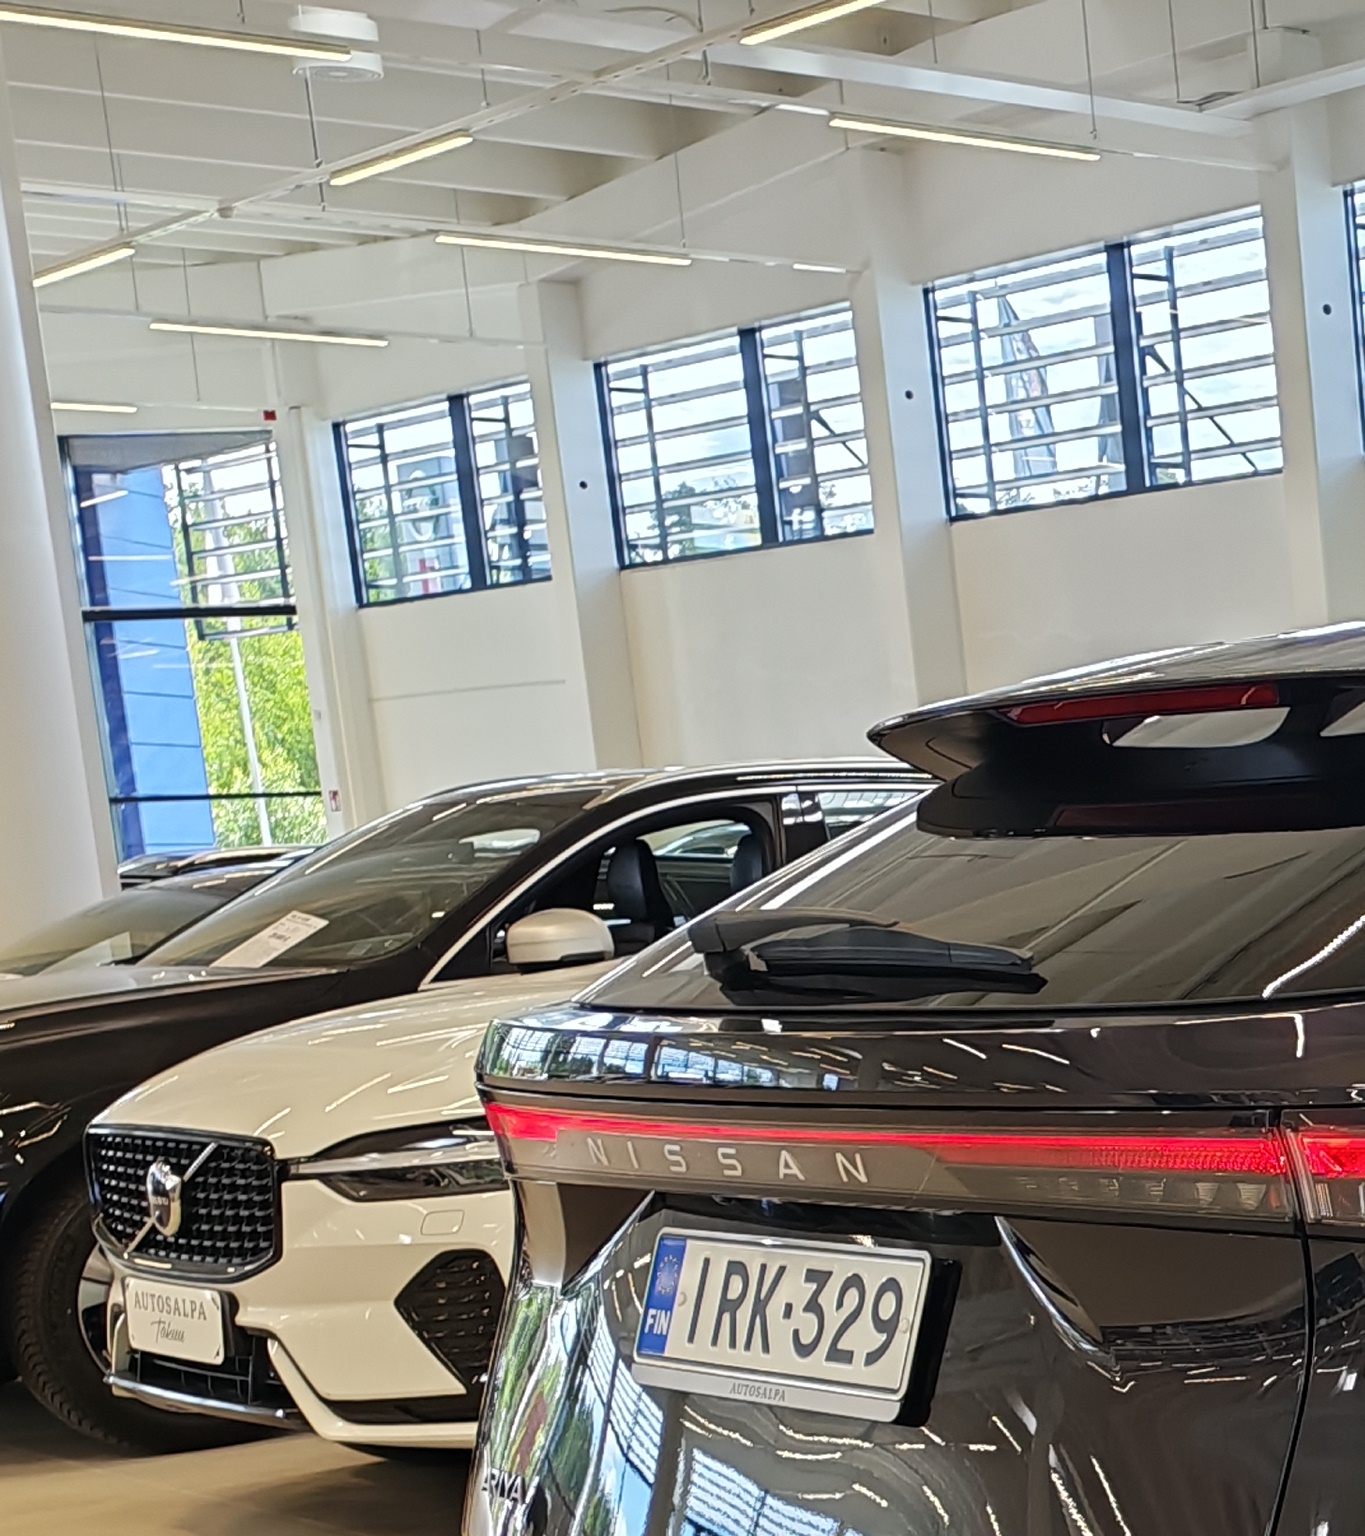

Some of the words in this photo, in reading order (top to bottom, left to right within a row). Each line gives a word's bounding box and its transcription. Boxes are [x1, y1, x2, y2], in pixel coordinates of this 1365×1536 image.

[586, 1136, 869, 1183] NISSAN
[134, 1290, 208, 1321] AUTOSALPA
[644, 1307, 671, 1336] FIN
[729, 1381, 787, 1402] AUTOSALPA
